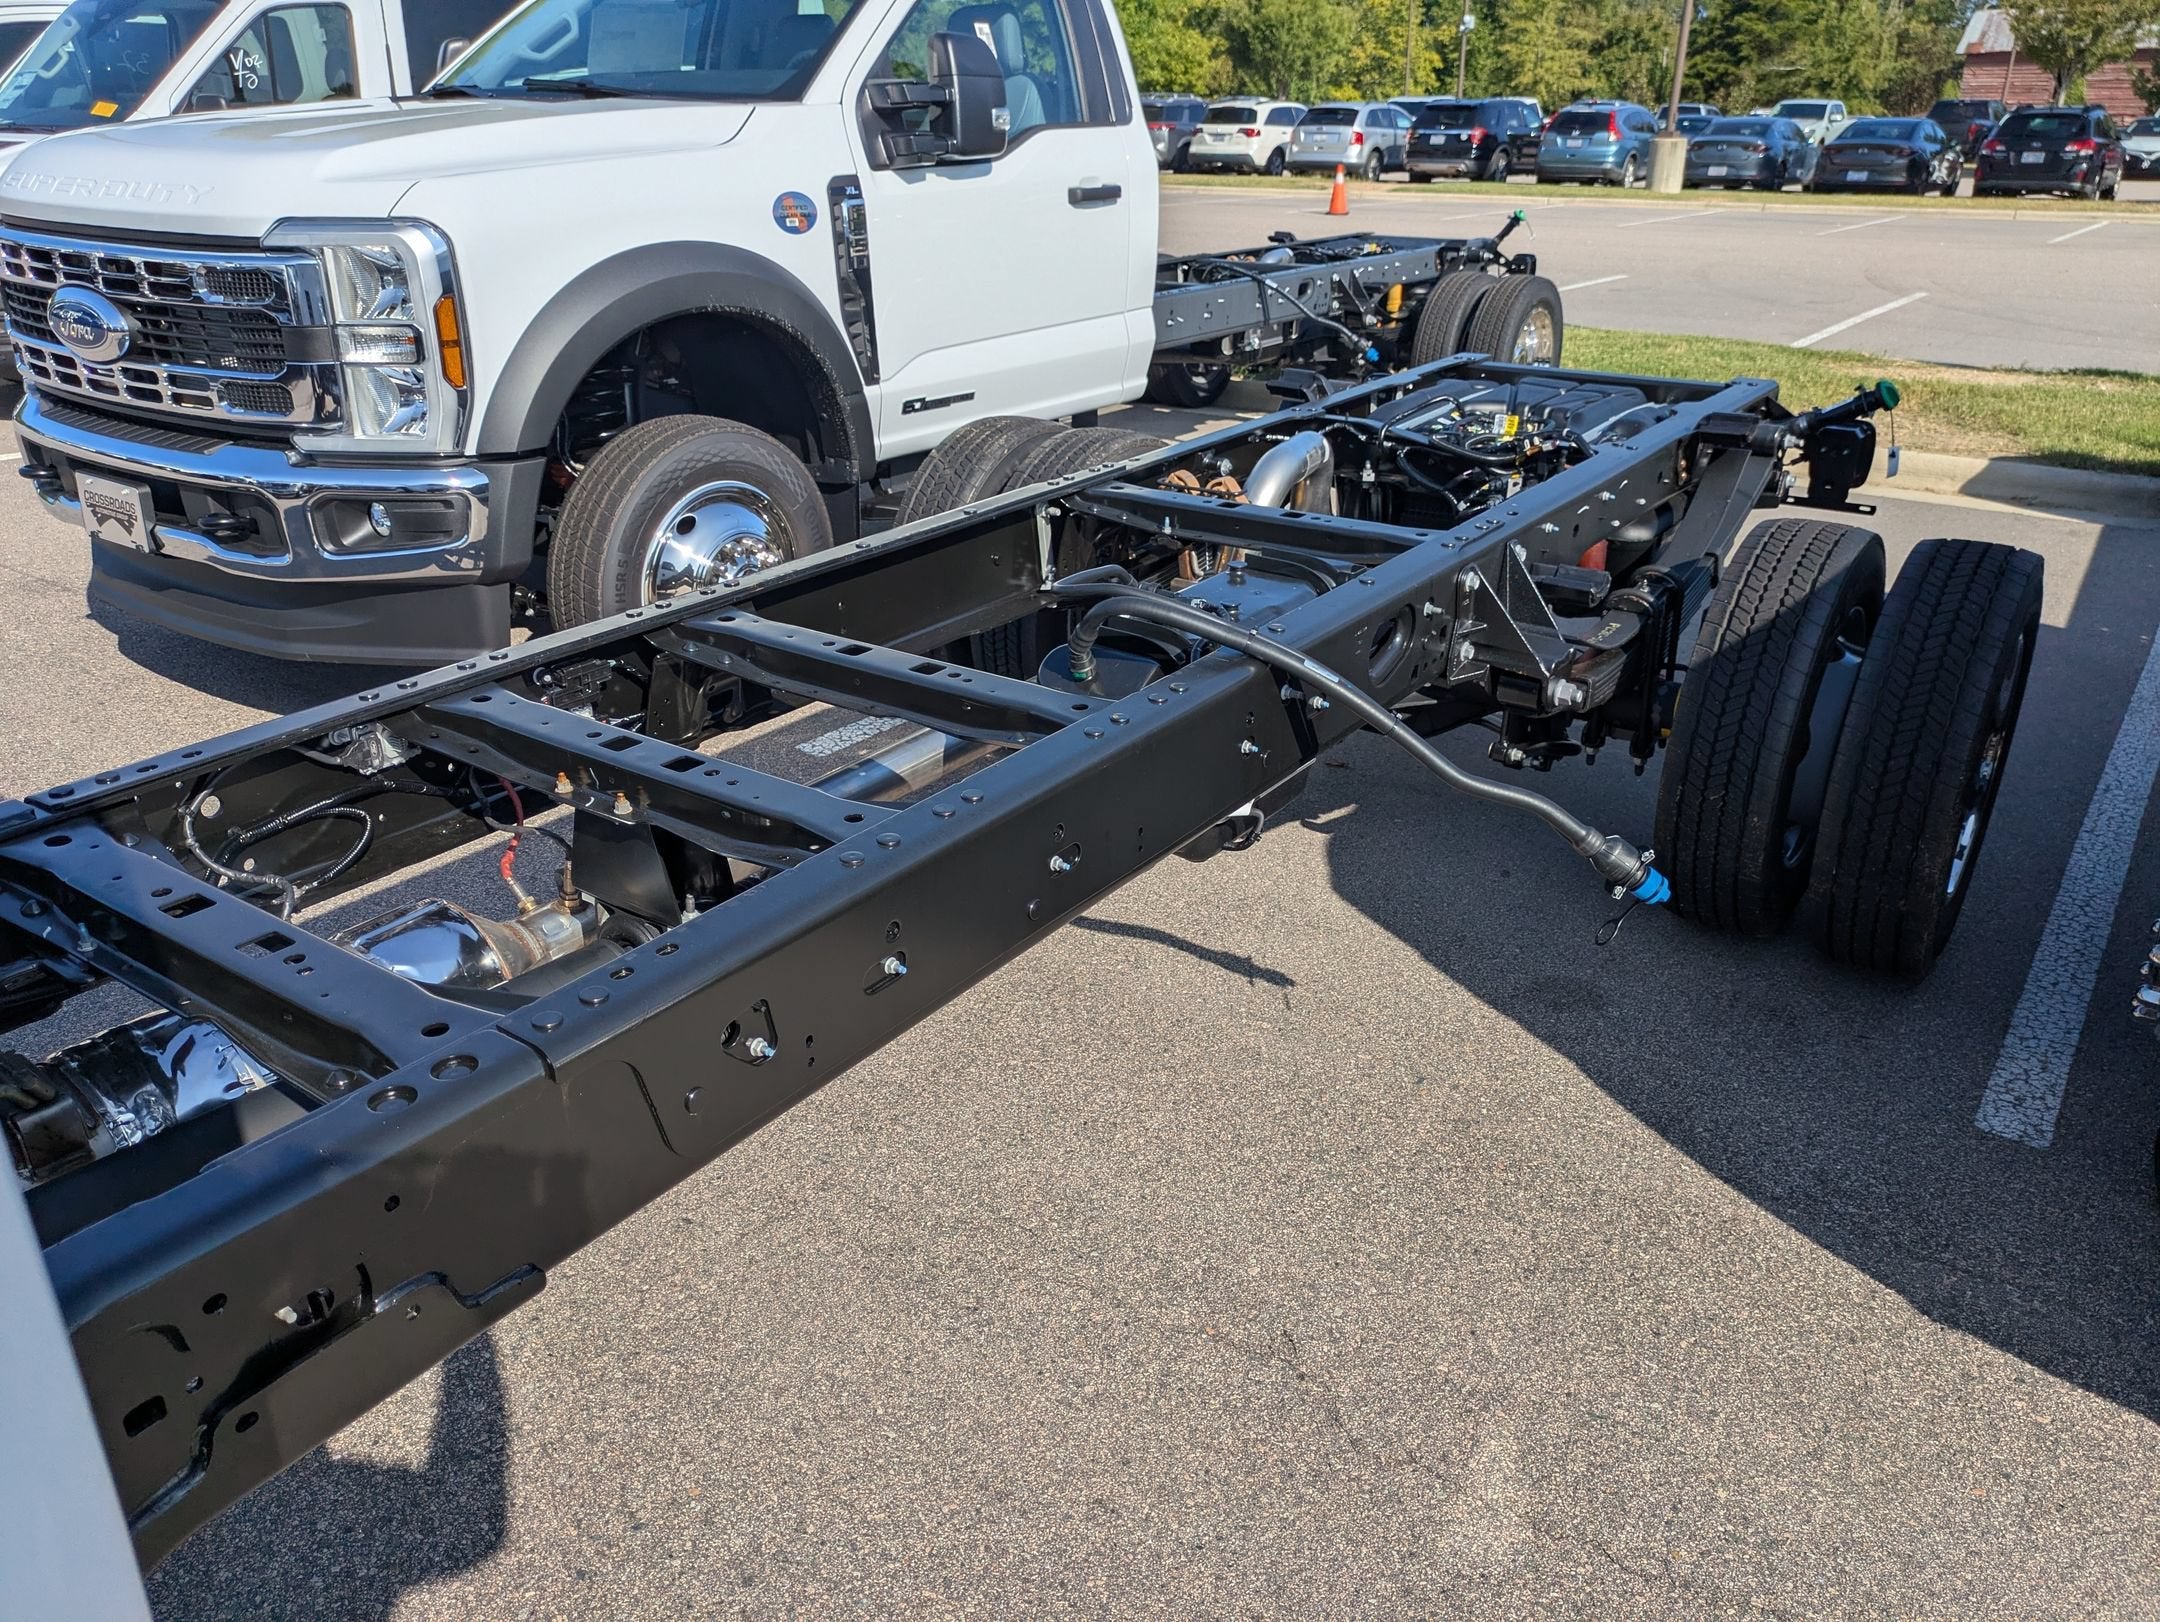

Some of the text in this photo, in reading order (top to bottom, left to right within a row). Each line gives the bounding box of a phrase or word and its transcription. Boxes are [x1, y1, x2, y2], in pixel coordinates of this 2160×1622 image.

[3, 171, 215, 205] SUPER DUTY
[845, 185, 860, 195] XL
[84, 489, 136, 514] CROSSROADS
[615, 559, 629, 604] HSR 5
